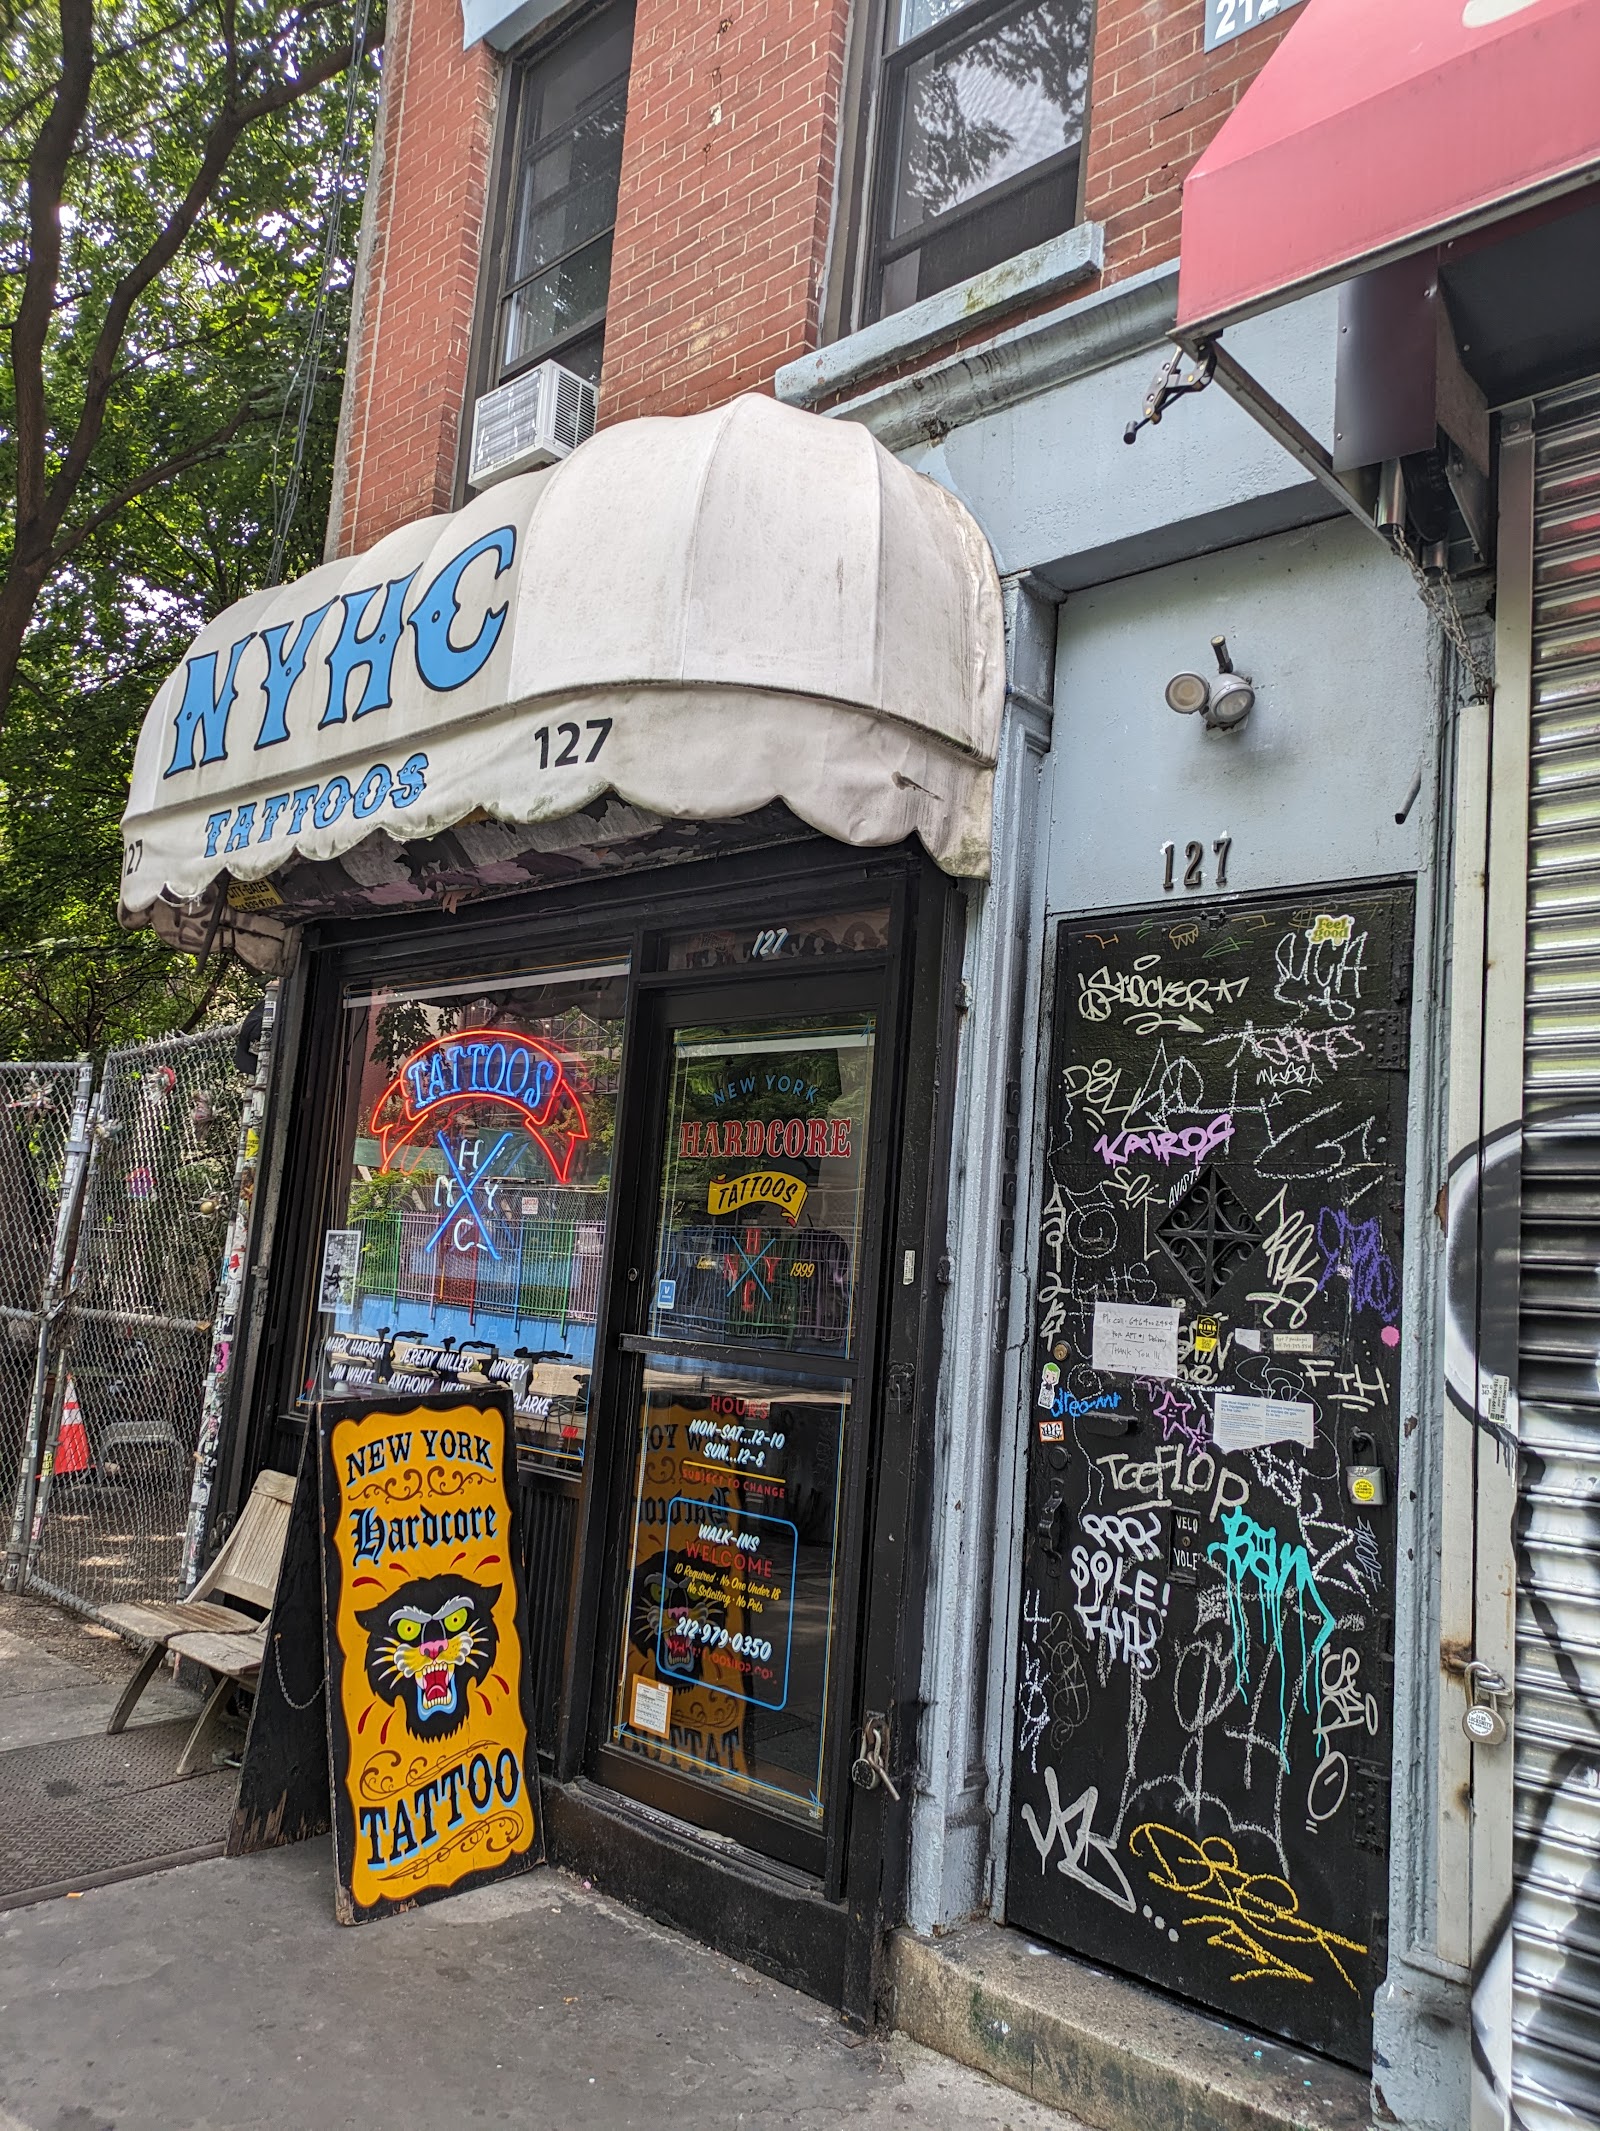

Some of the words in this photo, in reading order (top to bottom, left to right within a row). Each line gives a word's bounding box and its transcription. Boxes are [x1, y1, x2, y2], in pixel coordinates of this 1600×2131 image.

[163, 524, 517, 779] NYHC
[534, 717, 613, 769] 127
[204, 753, 429, 858] TATTOOS
[1163, 838, 1232, 889] 127
[1310, 928, 1349, 942] good
[1317, 917, 1348, 929] Feel
[752, 928, 789, 958] 127
[407, 1042, 555, 1109] TATTOOS
[713, 1076, 756, 1107] NEW
[765, 1075, 819, 1105] YORK
[679, 1118, 851, 1159] HARDCORE
[718, 1175, 798, 1210] TATTOOS
[790, 1262, 815, 1279] 1999
[1198, 1323, 1217, 1332] RINK
[325, 1337, 351, 1354] MARK
[350, 1339, 386, 1360] HARADA
[400, 1348, 438, 1368] JEREMY
[436, 1354, 474, 1373] MILLER
[329, 1364, 347, 1381] JIM
[346, 1367, 376, 1385] WHITE
[388, 1373, 435, 1394] ANTHONY
[513, 1393, 553, 1416] CLARKE
[710, 1394, 769, 1420] HOURS
[346, 1432, 413, 1487] NEW
[420, 1429, 495, 1472] YORK
[682, 1468, 724, 1486] SUBJECT
[727, 1478, 740, 1489] TO
[743, 1481, 786, 1499] CHANGE
[349, 1504, 498, 1568] Hardcore
[698, 1524, 761, 1553] WALK-INS
[1176, 1514, 1198, 1534] VELO
[686, 1541, 773, 1579] WELCOME
[1173, 1547, 1198, 1571] VOLE
[683, 1565, 717, 1583] Required
[720, 1575, 730, 1588] No
[731, 1577, 746, 1592] One
[748, 1581, 771, 1598] Under
[771, 1586, 782, 1601] 18
[687, 1582, 697, 1594] No
[697, 1584, 731, 1608] Soliciting
[736, 1595, 746, 1608] No
[747, 1598, 763, 1613] Pets
[360, 1747, 521, 1870] TATTOO
